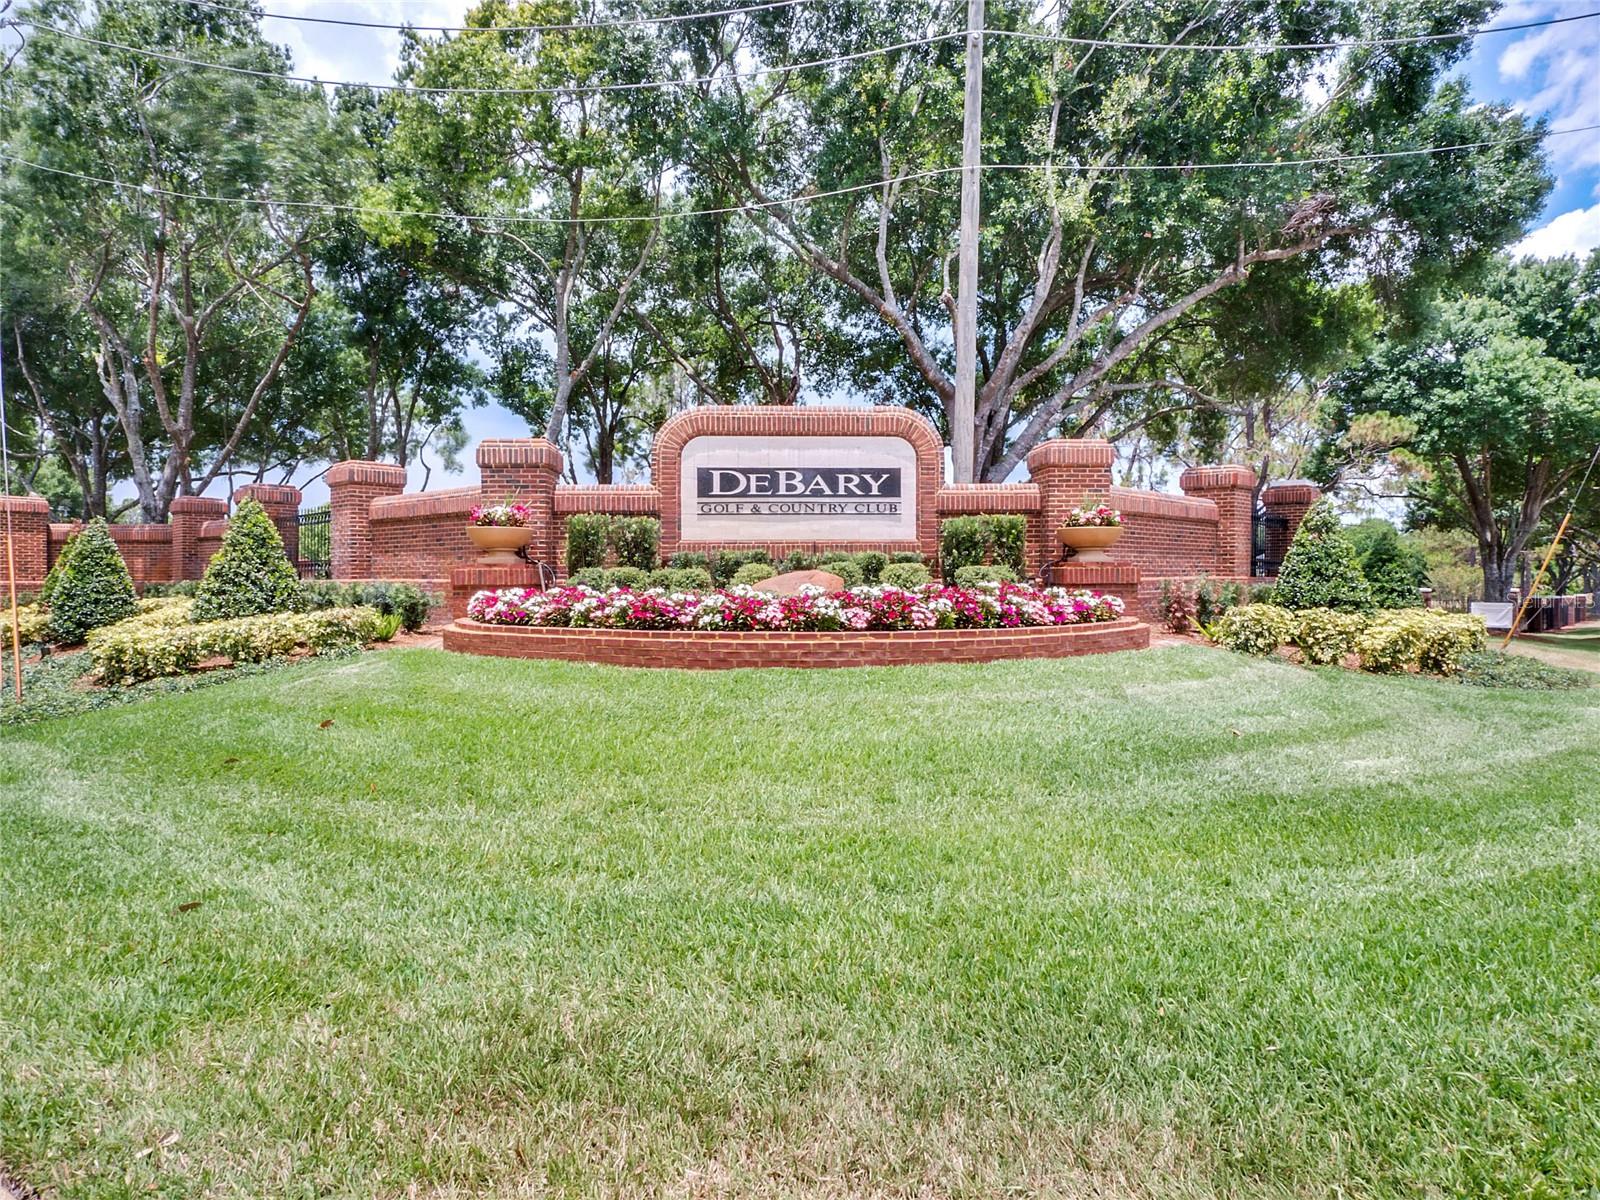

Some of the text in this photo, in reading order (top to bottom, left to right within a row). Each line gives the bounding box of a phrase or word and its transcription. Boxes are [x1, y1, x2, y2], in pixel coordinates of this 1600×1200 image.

[700, 503, 898, 513] GOLF & COUNTRY CLUB
